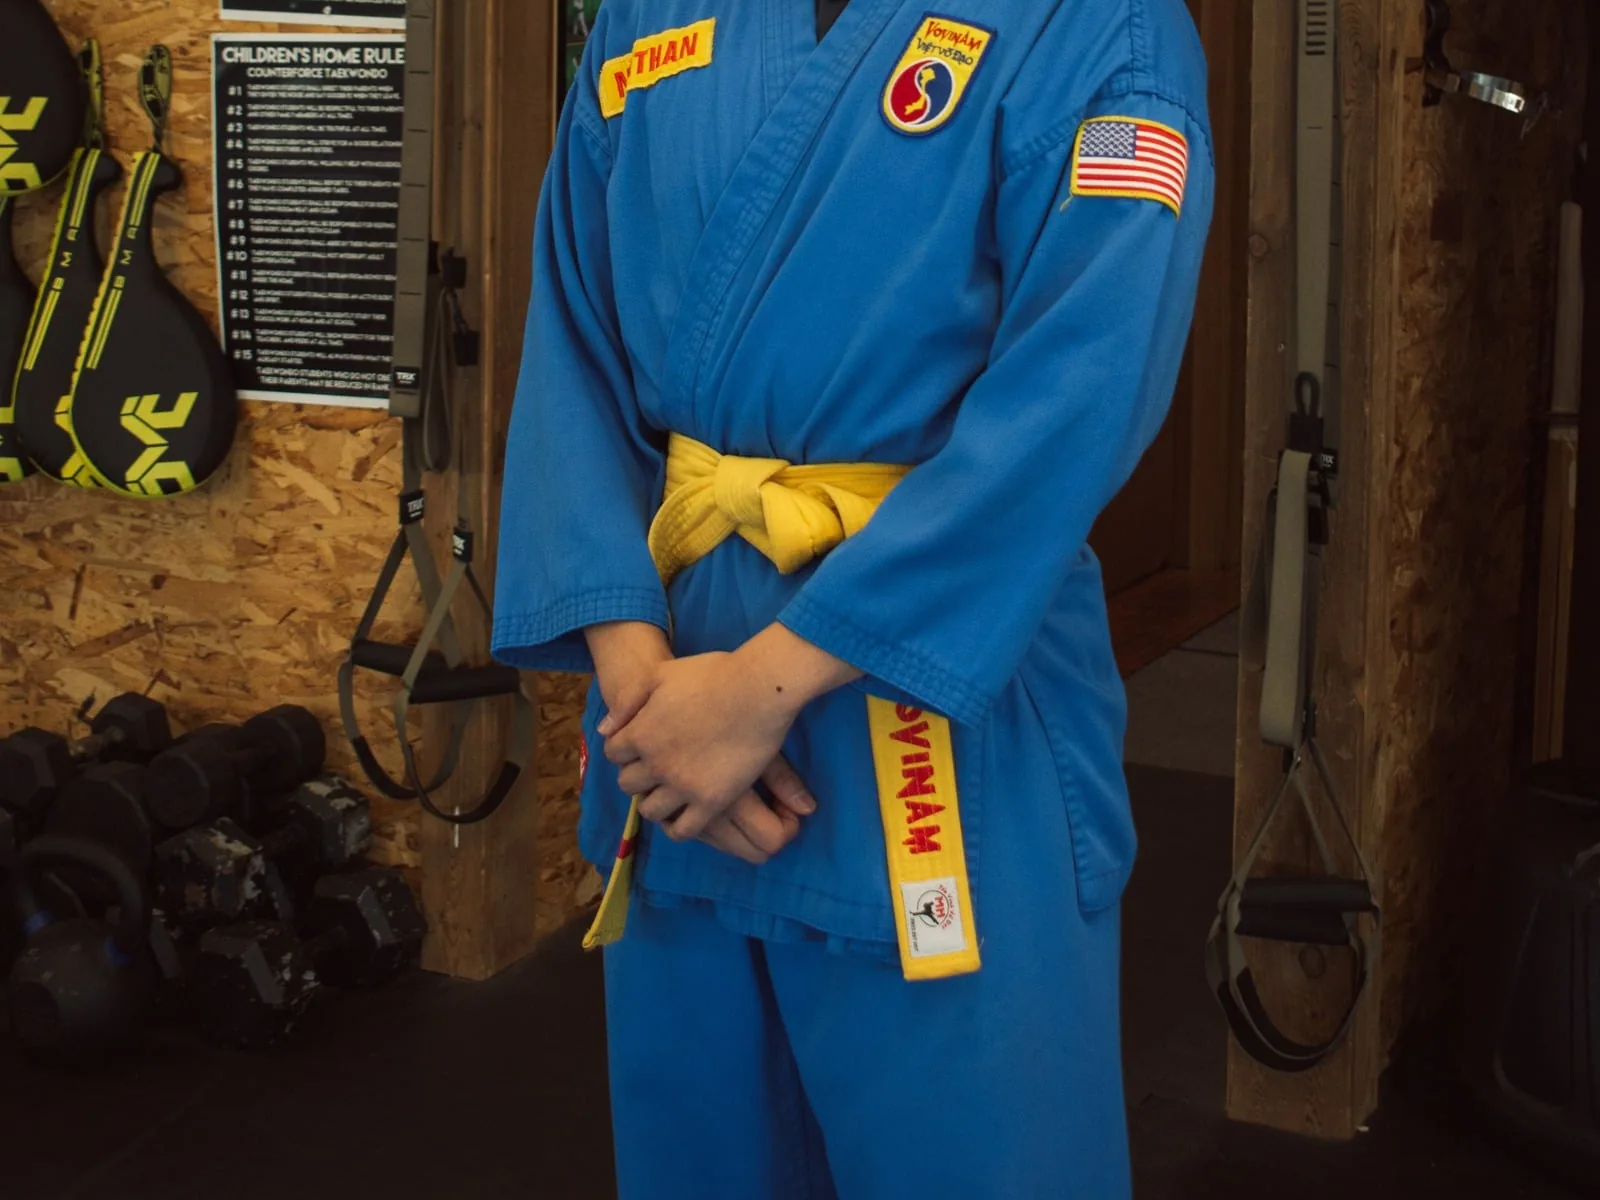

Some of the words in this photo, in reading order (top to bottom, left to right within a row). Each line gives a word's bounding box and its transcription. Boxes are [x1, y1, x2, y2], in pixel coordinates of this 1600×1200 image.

[222, 46, 310, 63] CHILDREN'S
[313, 47, 361, 64] HOME
[364, 48, 406, 64] RULE
[247, 67, 324, 78] COUNTERFORCE
[325, 68, 388, 79] TAEKWONDO
[613, 32, 699, 99] NTHAN
[889, 703, 946, 854] OVINAM
